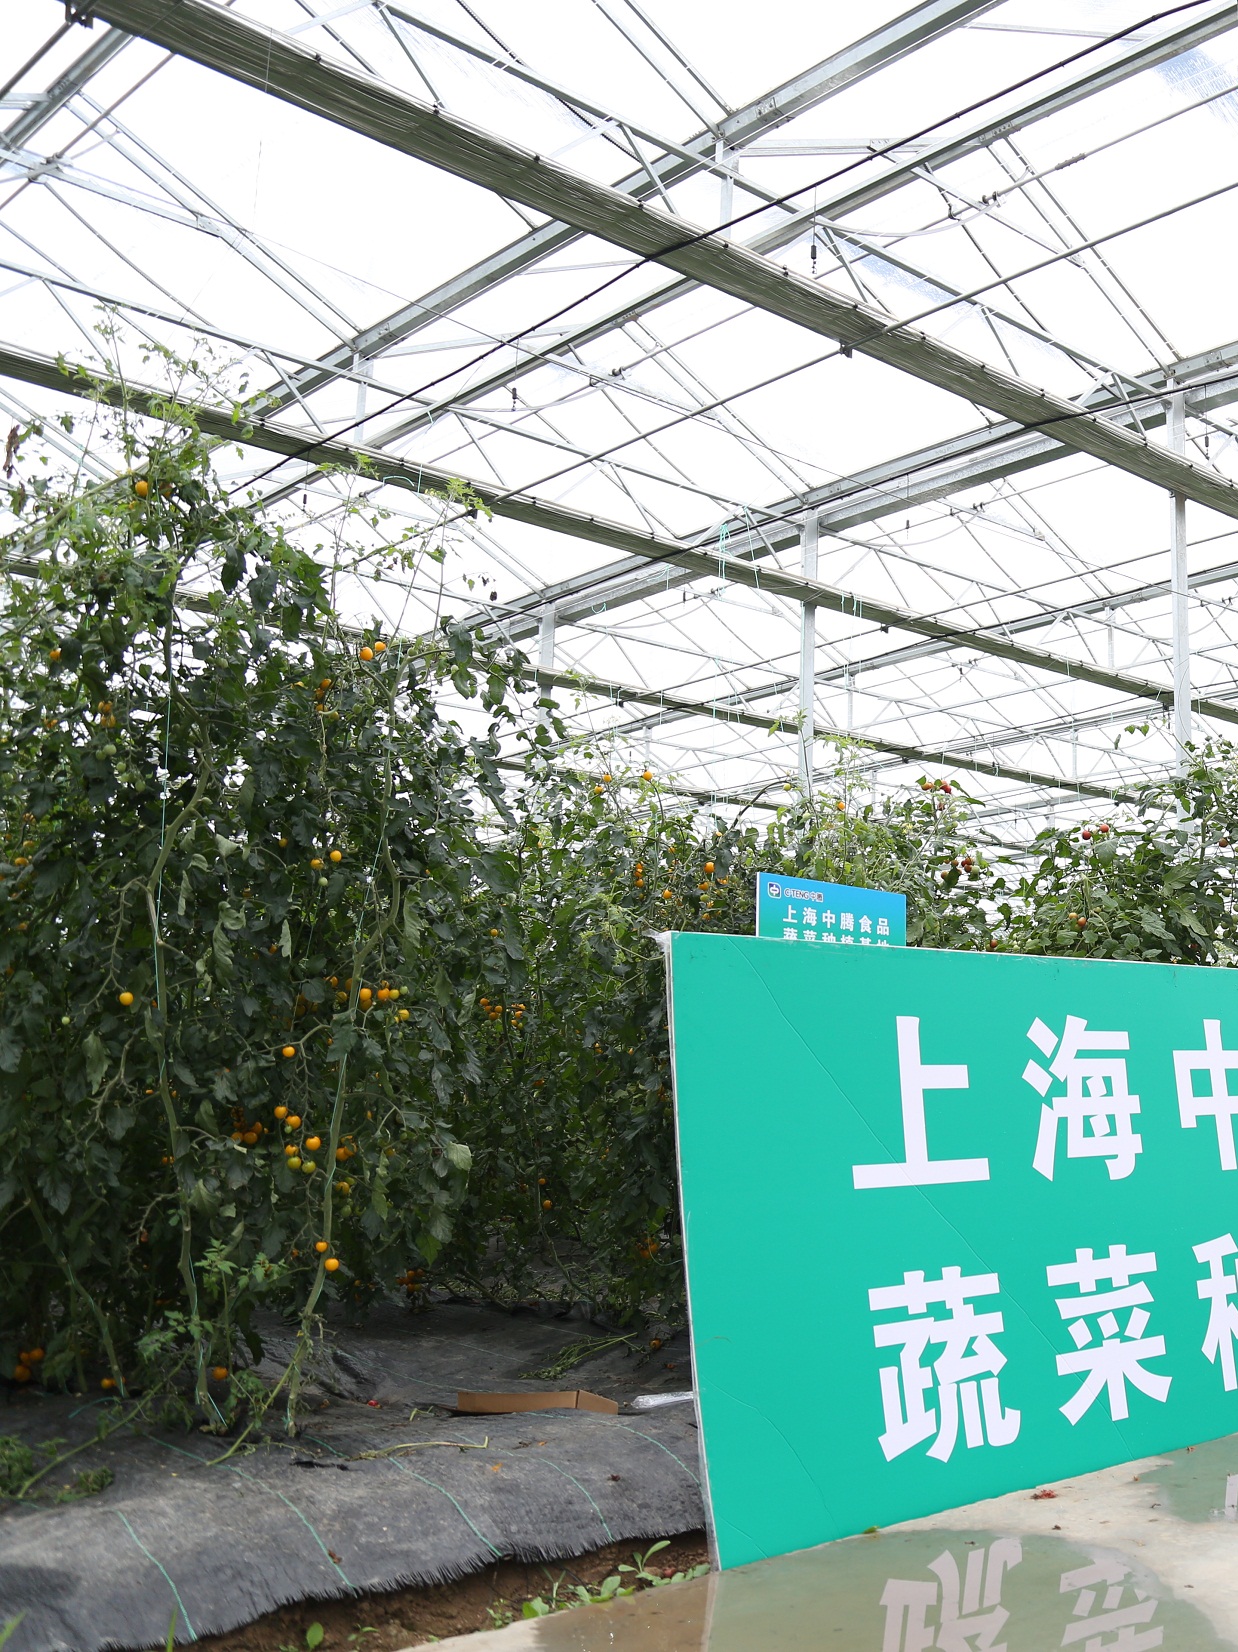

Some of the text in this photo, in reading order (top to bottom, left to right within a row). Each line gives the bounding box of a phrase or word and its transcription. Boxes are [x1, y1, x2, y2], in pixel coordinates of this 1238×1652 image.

[782, 904, 890, 936] 上海中腾食品
